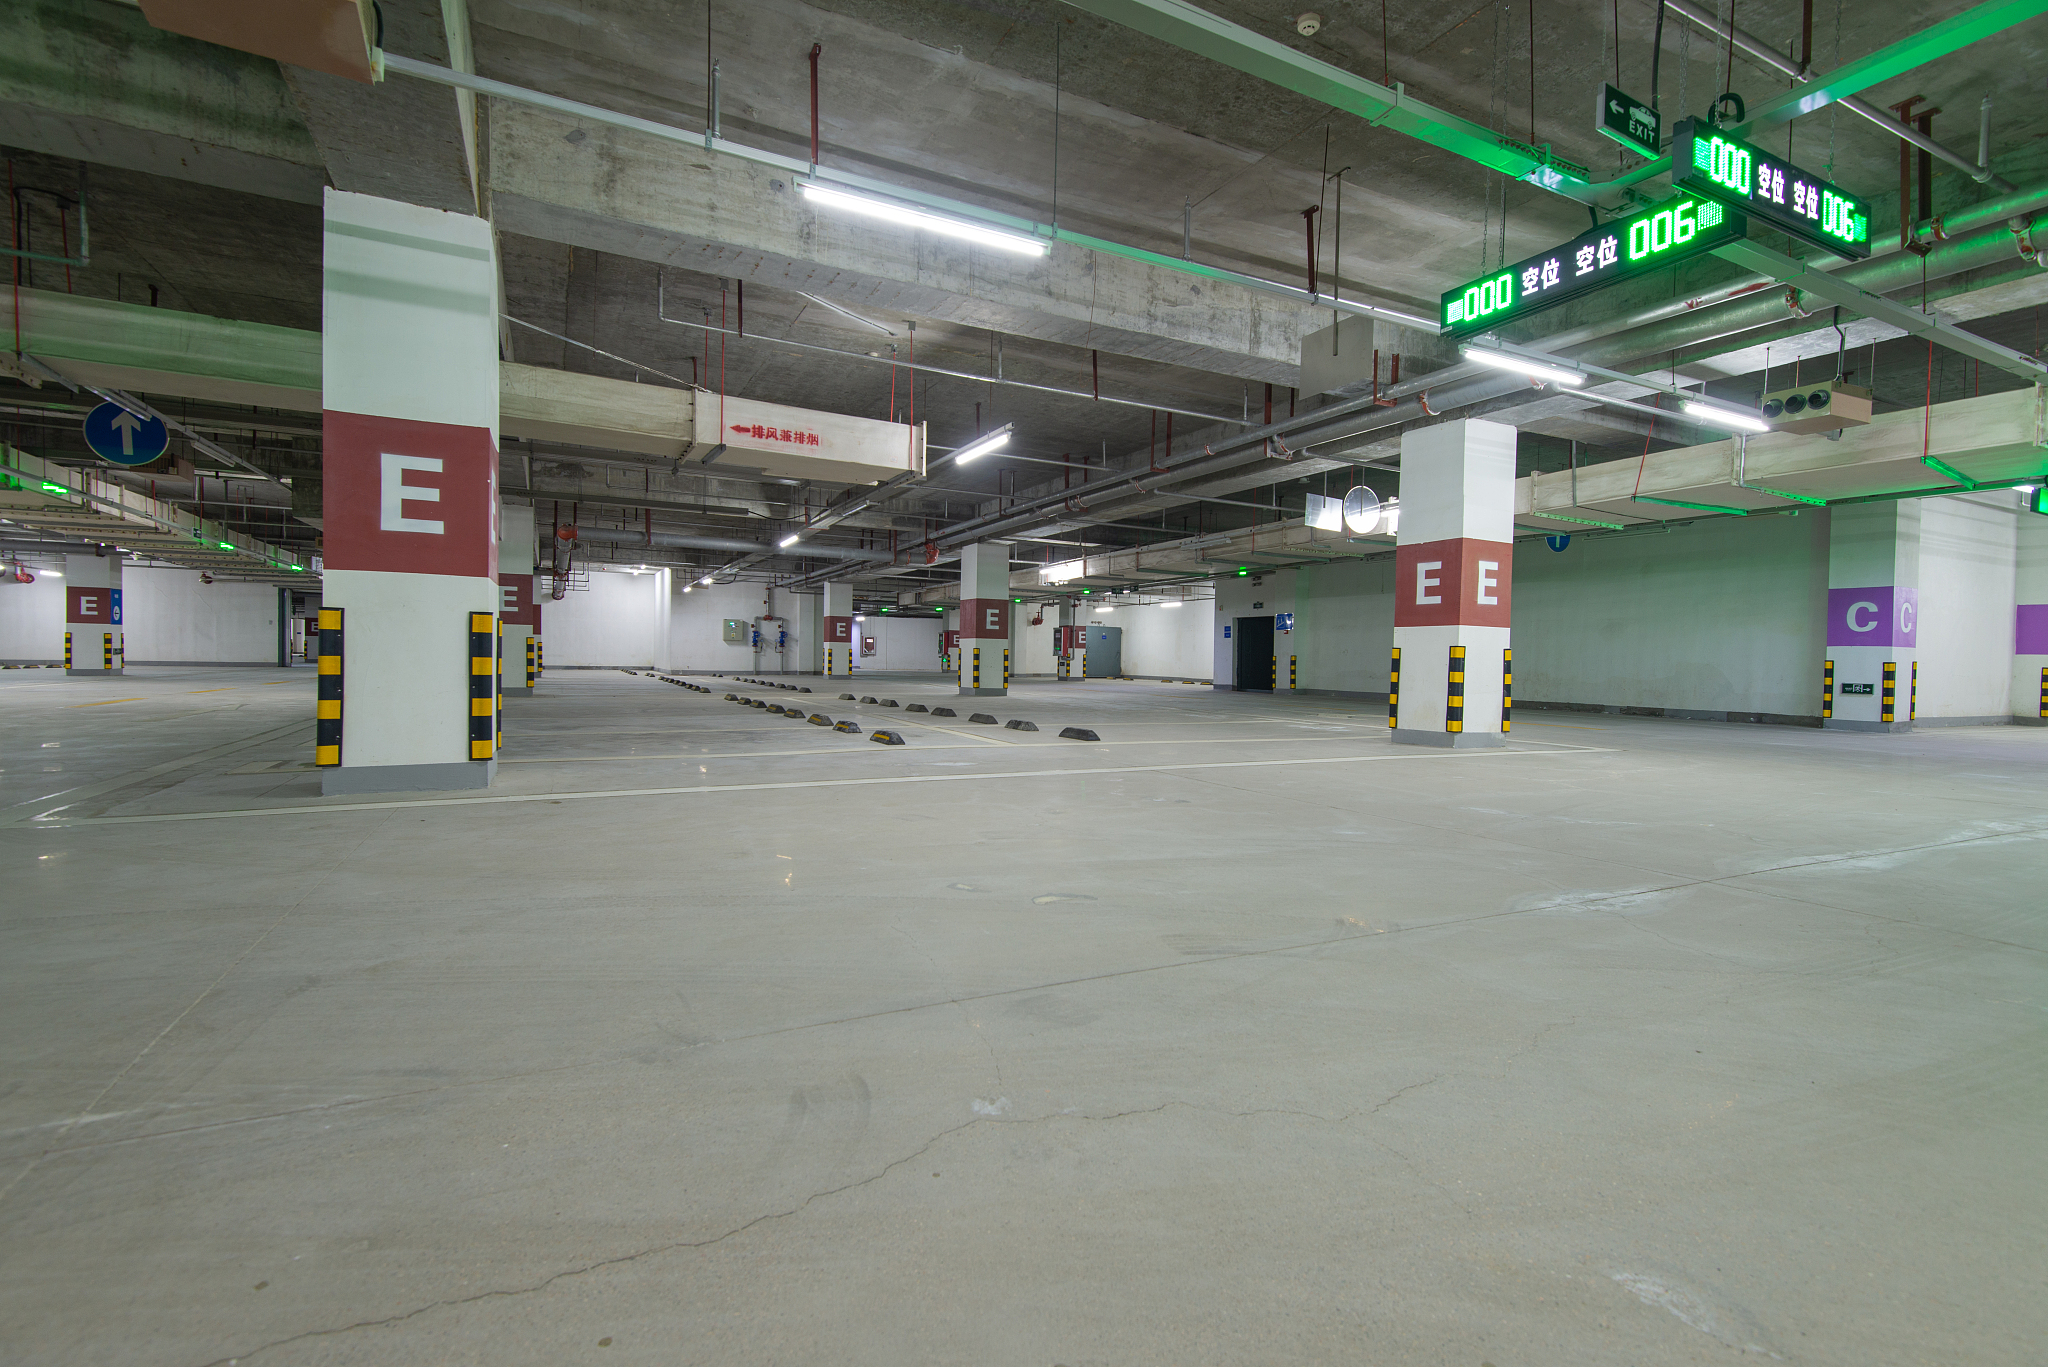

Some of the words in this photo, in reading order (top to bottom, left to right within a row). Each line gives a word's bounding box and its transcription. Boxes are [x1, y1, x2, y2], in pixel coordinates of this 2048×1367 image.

[1629, 119, 1655, 143] EXIT
[1710, 136, 1751, 195] 000
[1758, 163, 1785, 204] 空位
[1793, 180, 1819, 220] 空位
[1822, 189, 1855, 242] 006
[1463, 272, 1513, 322] 000
[1522, 257, 1560, 297] 空位
[1575, 234, 1618, 277] 空位
[1629, 200, 1696, 261] 006
[751, 423, 819, 447] 排风兼排烟
[380, 452, 445, 535] E
[1416, 560, 1442, 605] E
[1477, 560, 1499, 605] E
[80, 596, 98, 615] E
[498, 585, 519, 612] E
[836, 622, 847, 637] E
[986, 608, 999, 629] E
[1846, 601, 1879, 633] C
[1900, 602, 1912, 633] C
[953, 634, 960, 645] E
[1078, 631, 1086, 643] E
